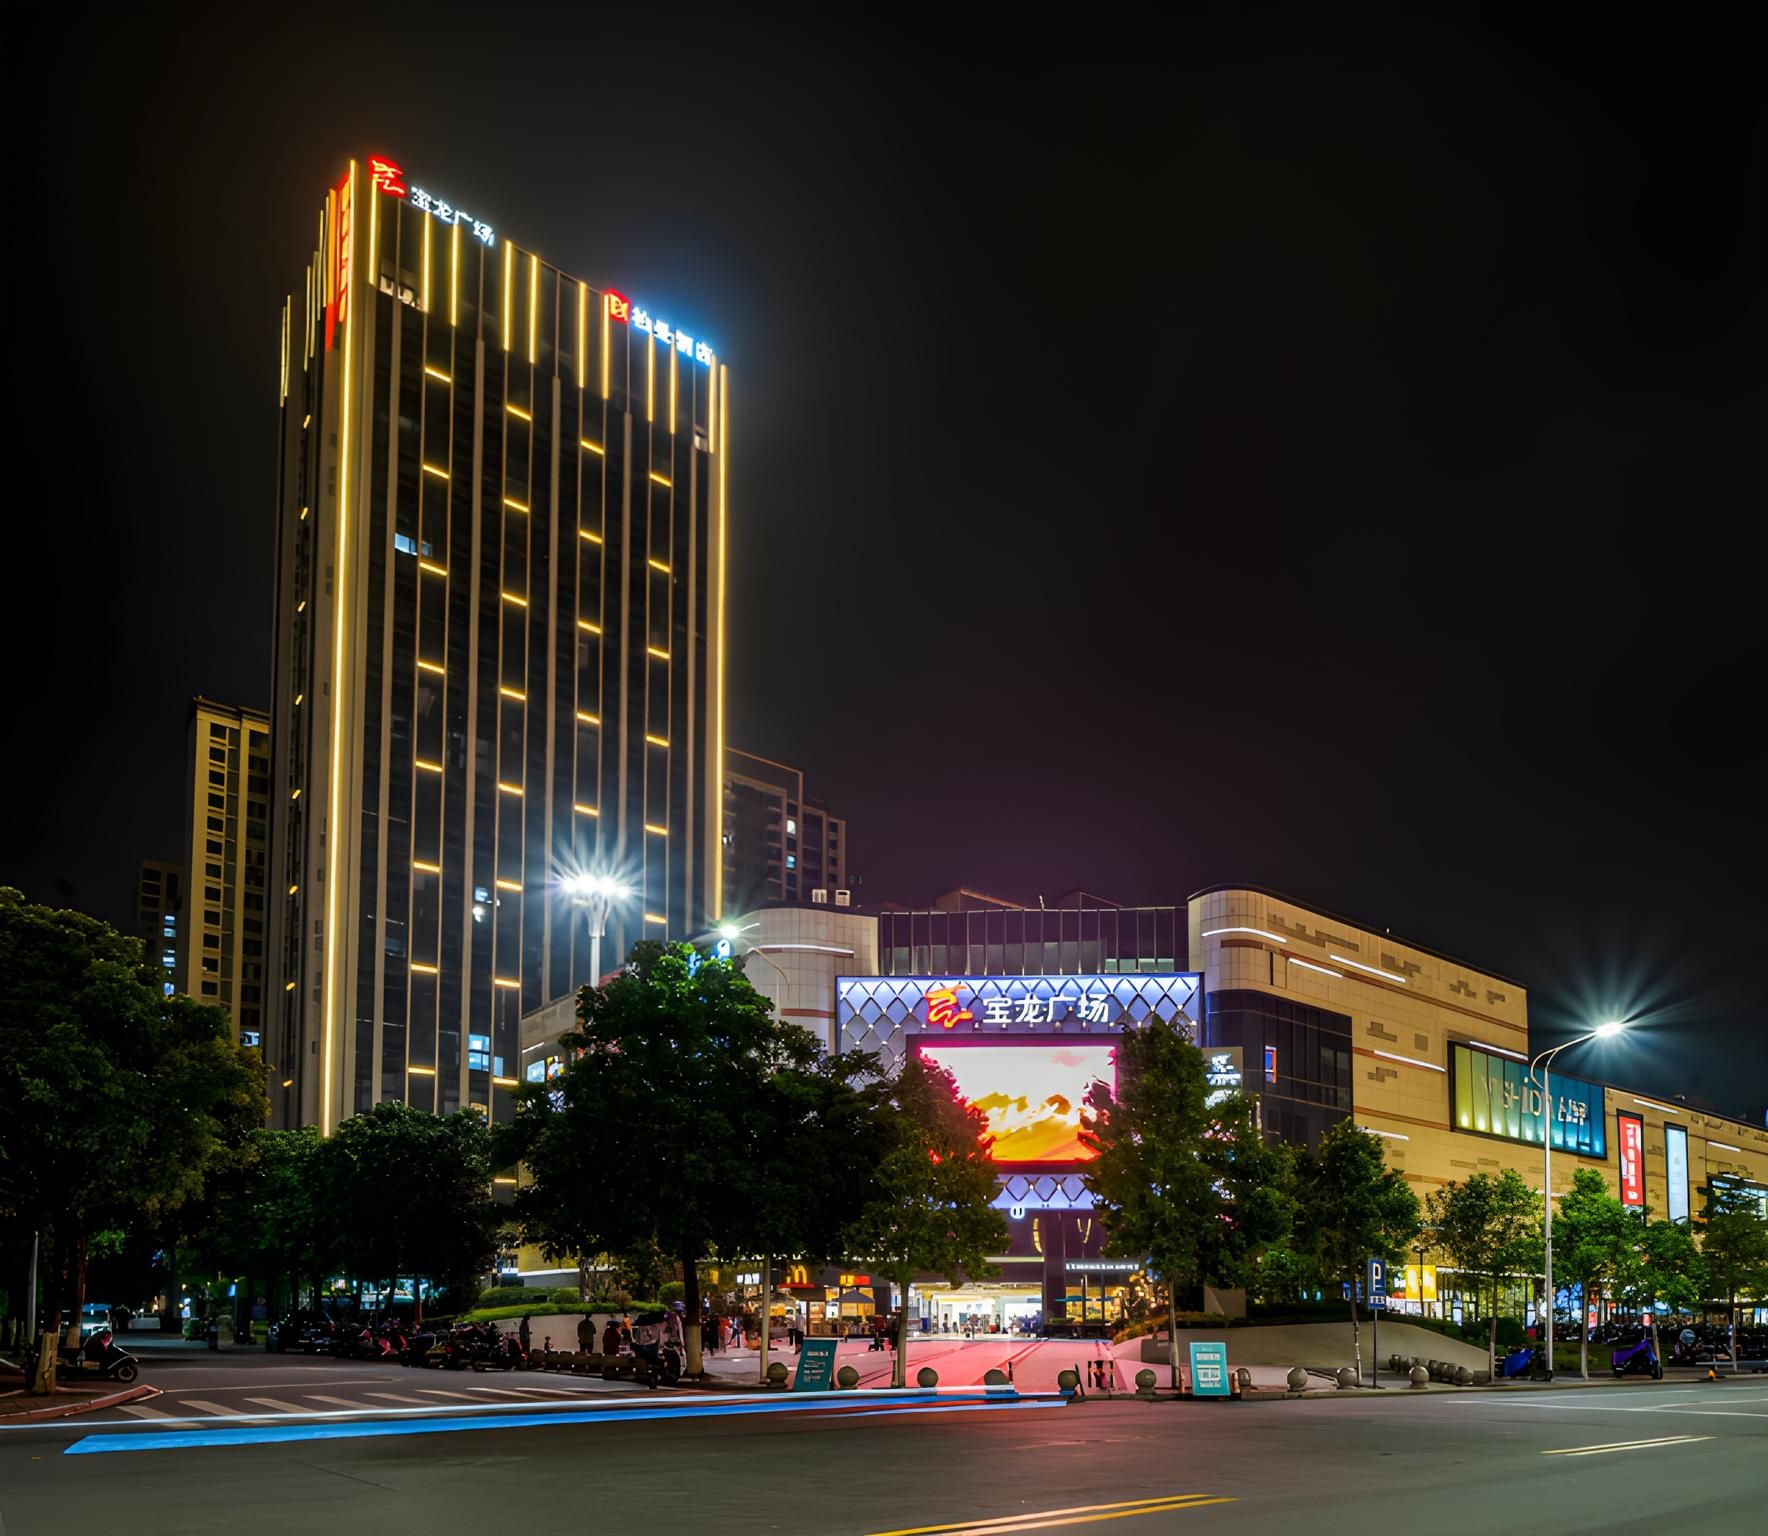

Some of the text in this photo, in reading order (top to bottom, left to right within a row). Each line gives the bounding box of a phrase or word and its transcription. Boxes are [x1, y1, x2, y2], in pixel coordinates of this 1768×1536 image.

[411, 186, 495, 247] 宝龙广场
[982, 993, 1110, 1024] 宝龙广场
